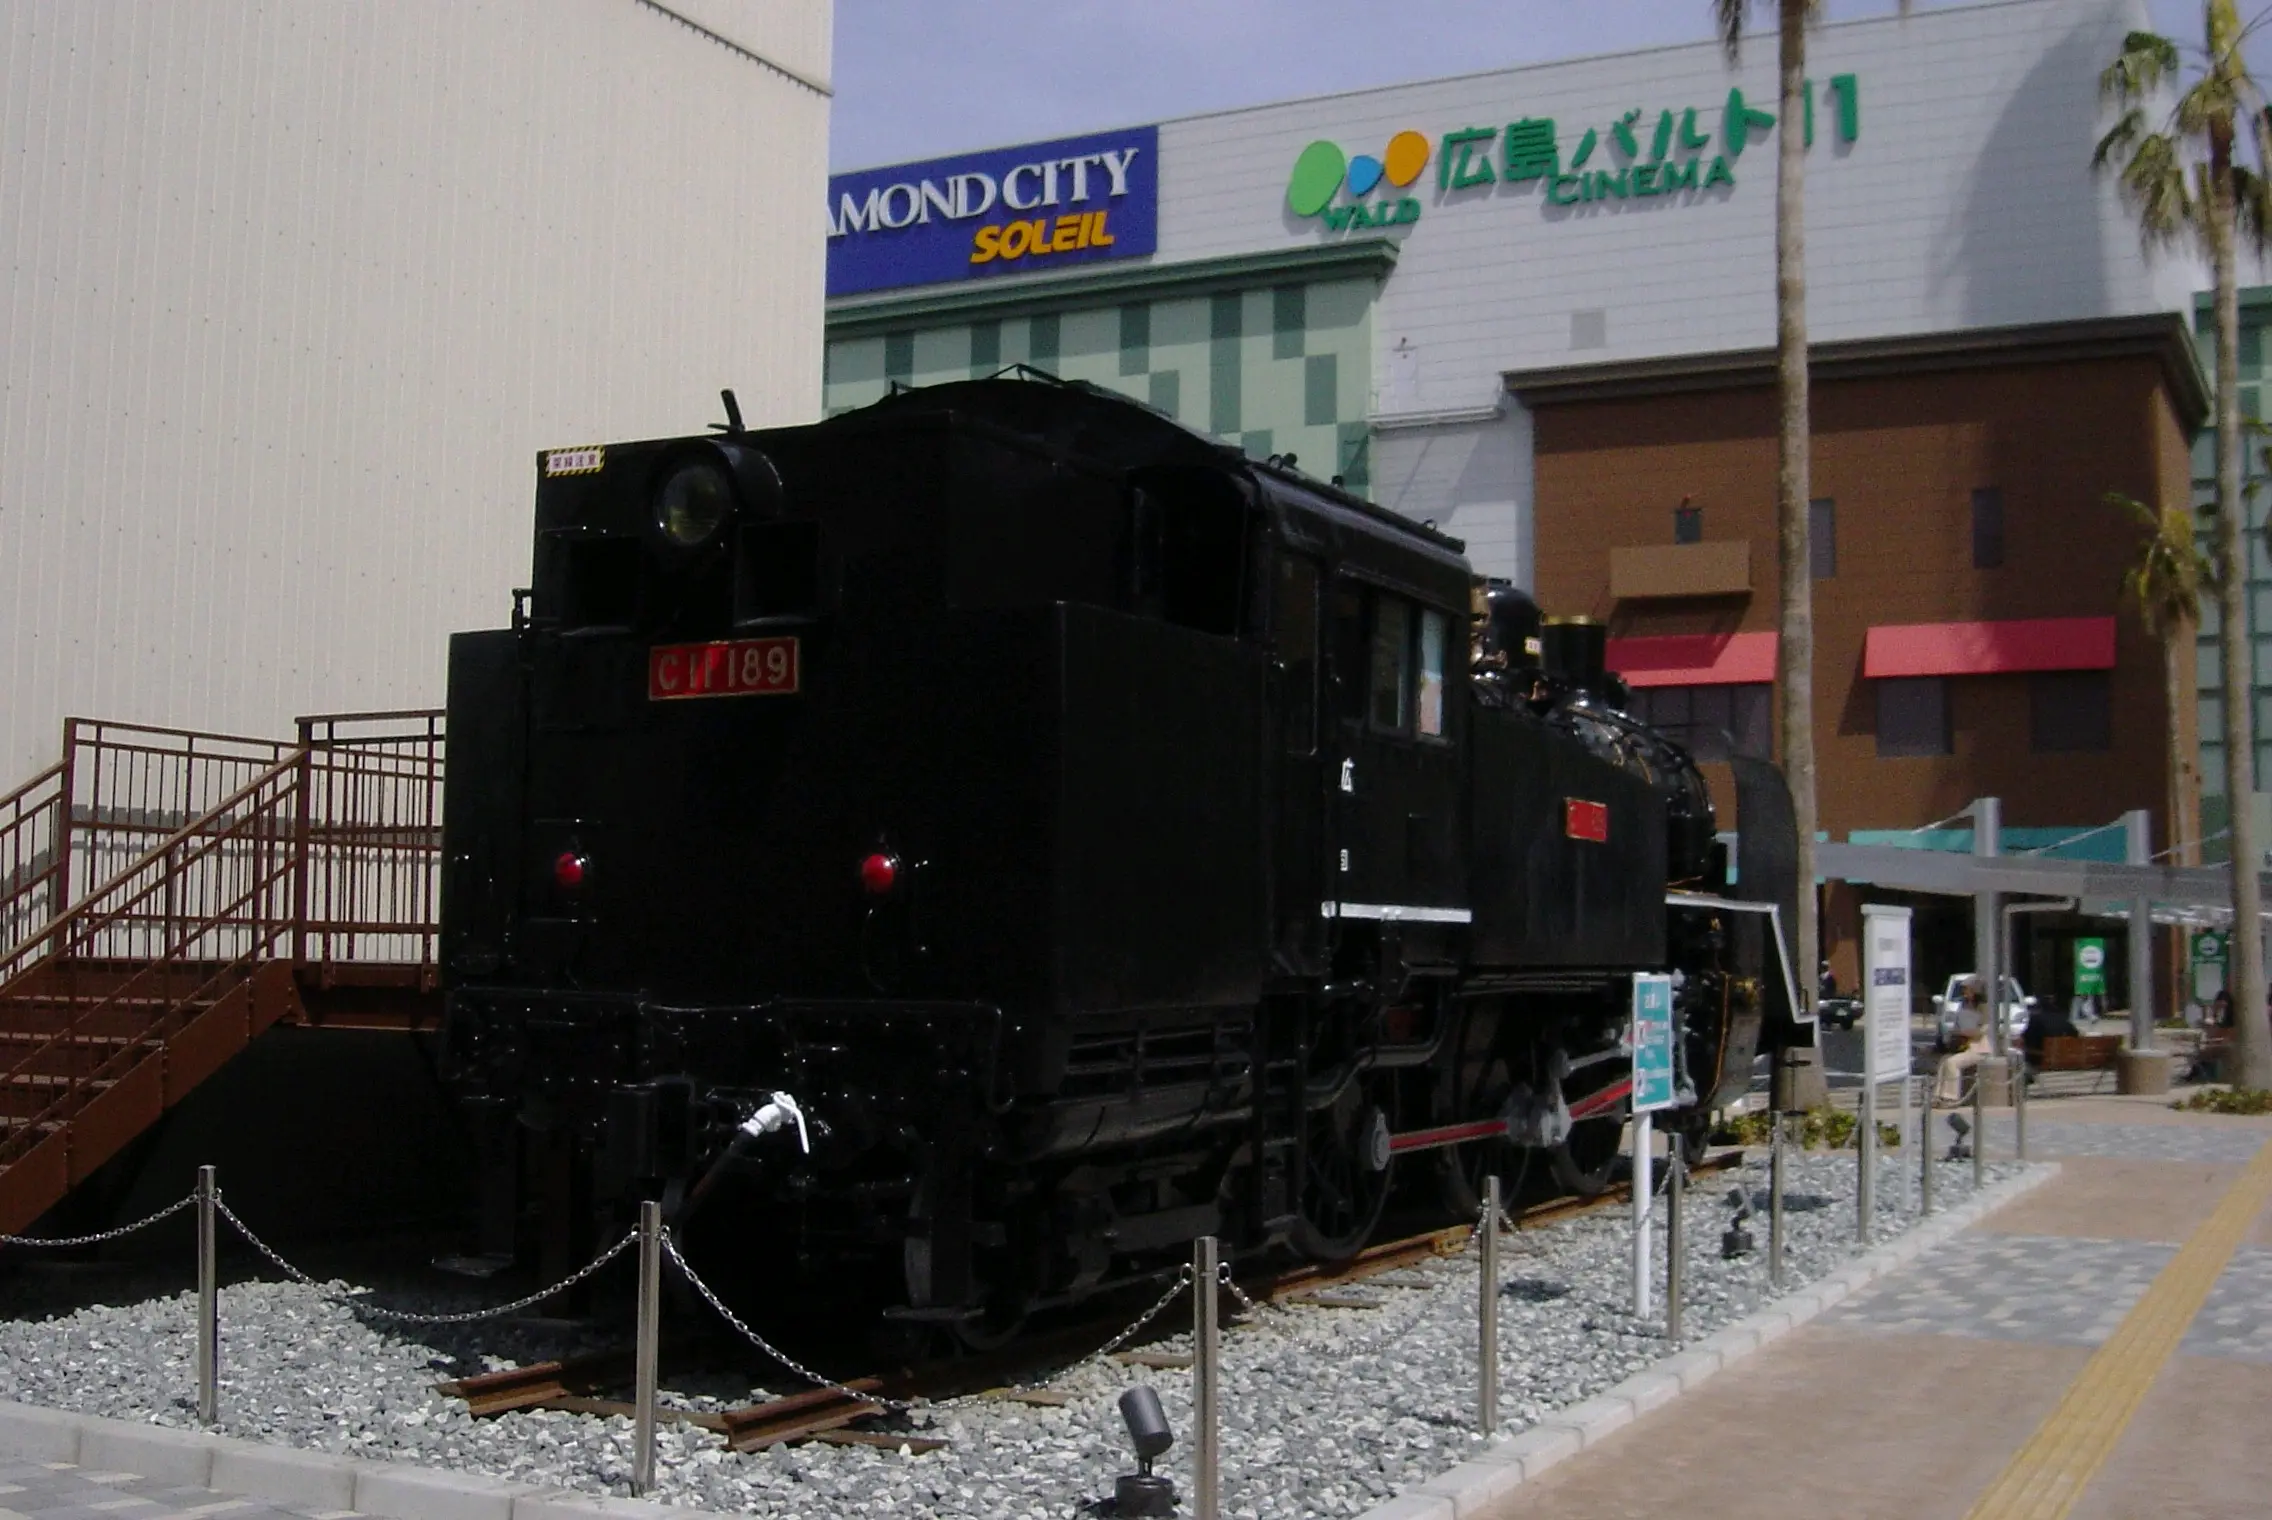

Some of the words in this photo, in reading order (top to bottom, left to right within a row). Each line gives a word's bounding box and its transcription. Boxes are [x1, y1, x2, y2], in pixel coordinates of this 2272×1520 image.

[1003, 148, 1139, 210] CITY
[1547, 155, 1735, 206] CINEMA
[970, 210, 1115, 264] SOLEIL
[1322, 197, 1421, 231] WALD
